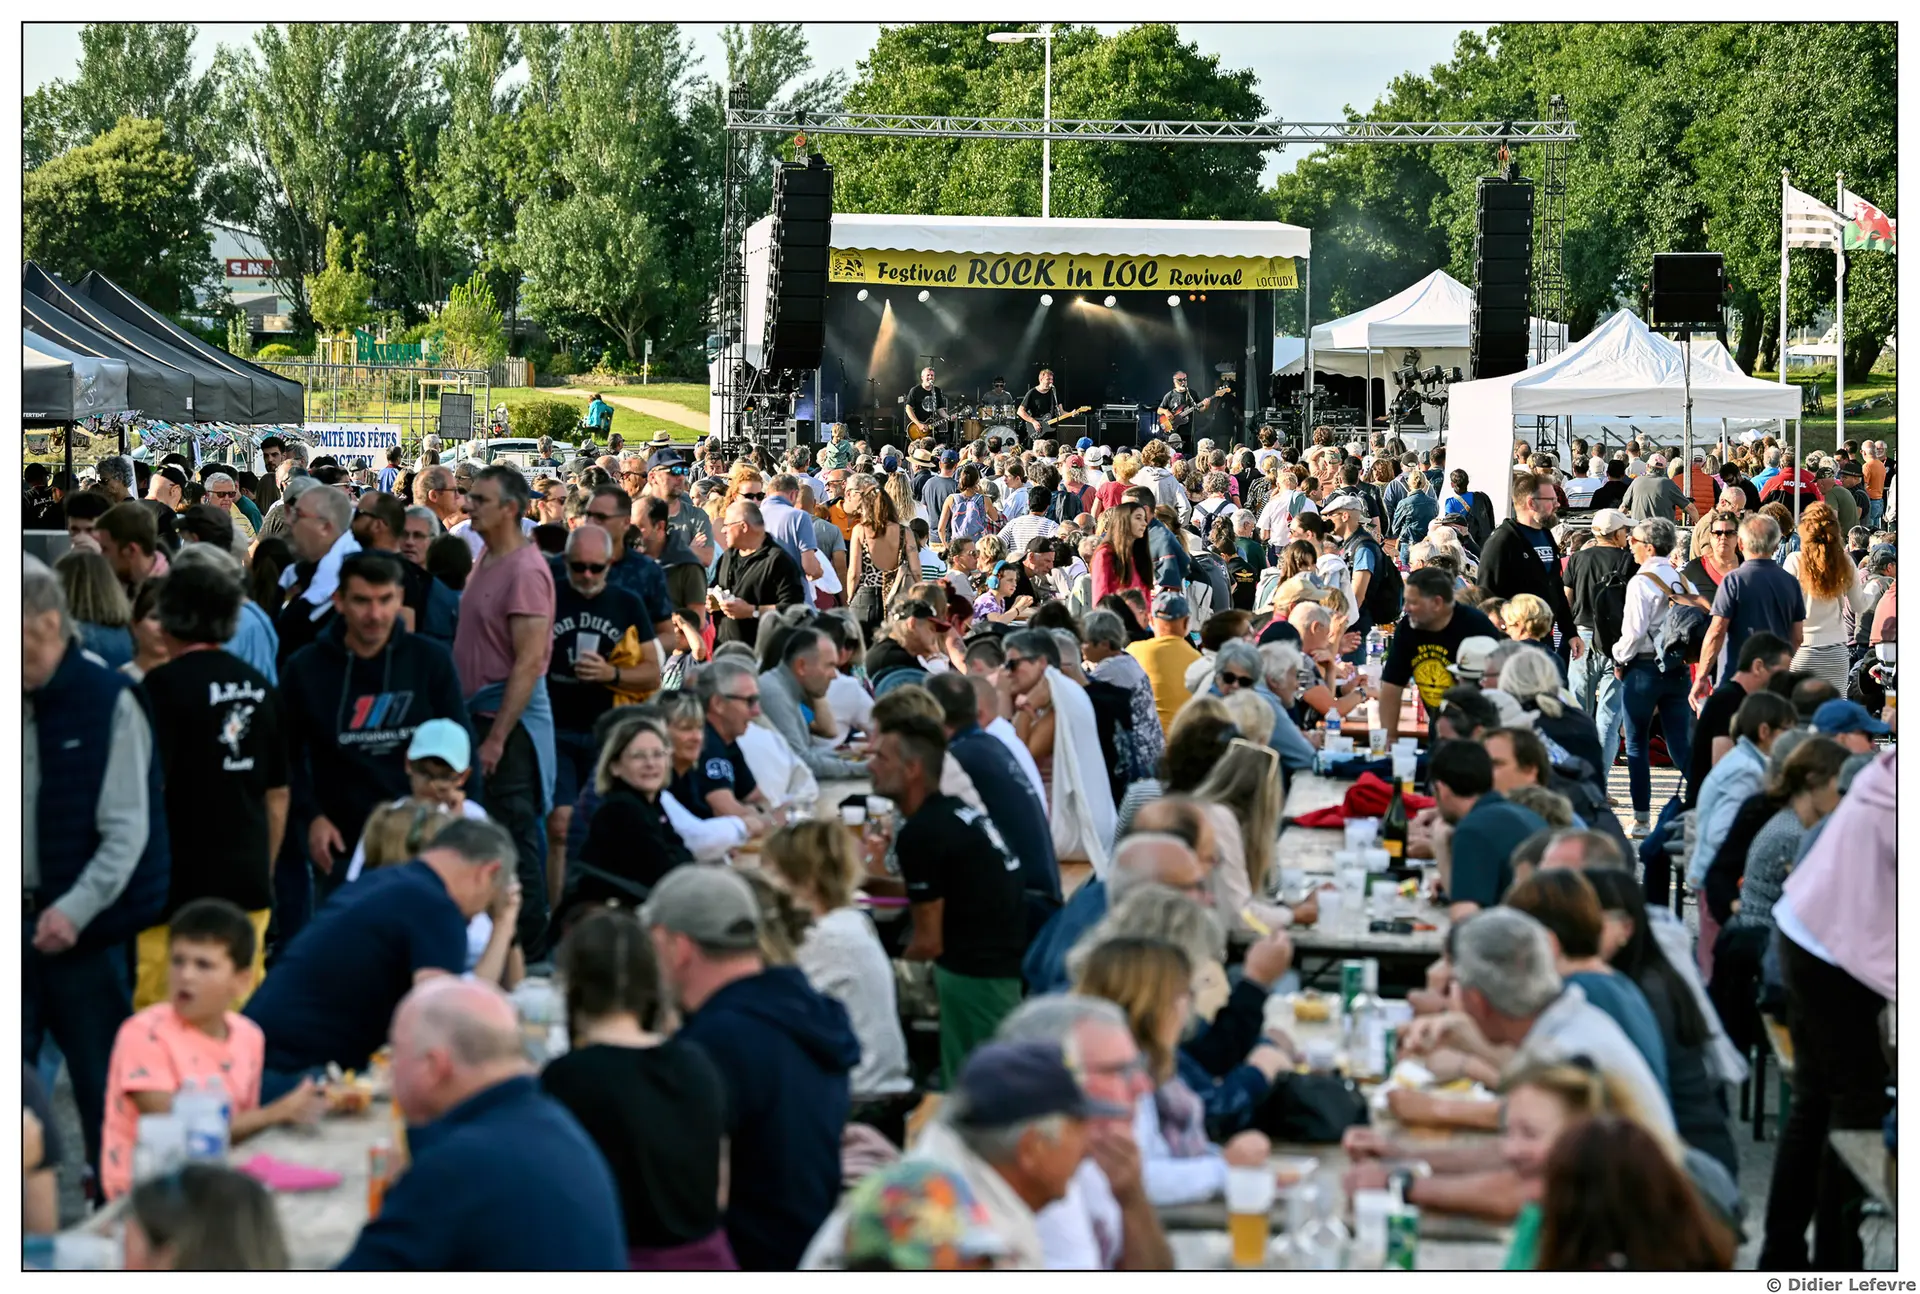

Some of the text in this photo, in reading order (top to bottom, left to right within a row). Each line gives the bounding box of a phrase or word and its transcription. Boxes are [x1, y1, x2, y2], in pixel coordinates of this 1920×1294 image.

[877, 257, 1243, 288] Festival ROCK in LOC Revival
[1256, 275, 1294, 288] LOCTUDY
[346, 430, 366, 448] DES
[367, 426, 397, 448] FÊTES
[1783, 480, 1807, 489] MOUL
[553, 611, 626, 644] on Dutc
